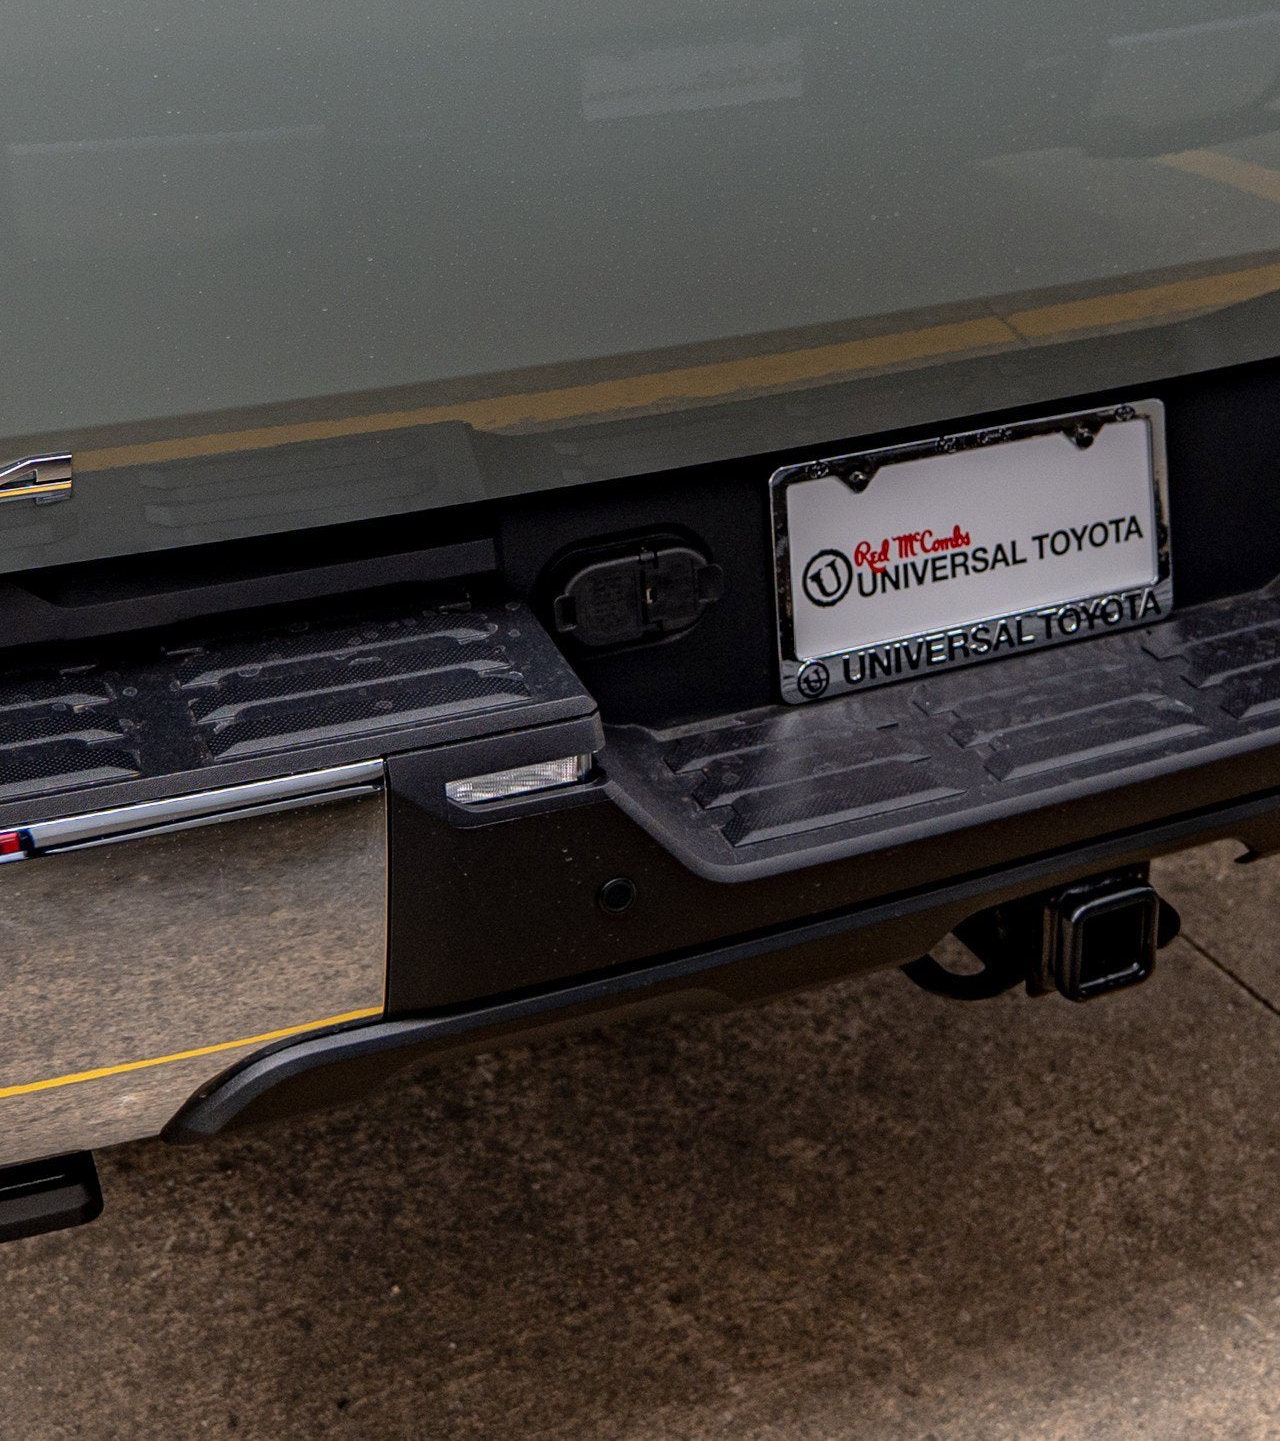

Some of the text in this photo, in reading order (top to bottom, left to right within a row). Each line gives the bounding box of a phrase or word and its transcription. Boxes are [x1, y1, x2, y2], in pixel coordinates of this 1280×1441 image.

[853, 525, 971, 573] Red McCombs
[857, 515, 1144, 597] UNIVERSAL TOYOTA
[841, 587, 1162, 685] UNIVERSAL TOYOTA
